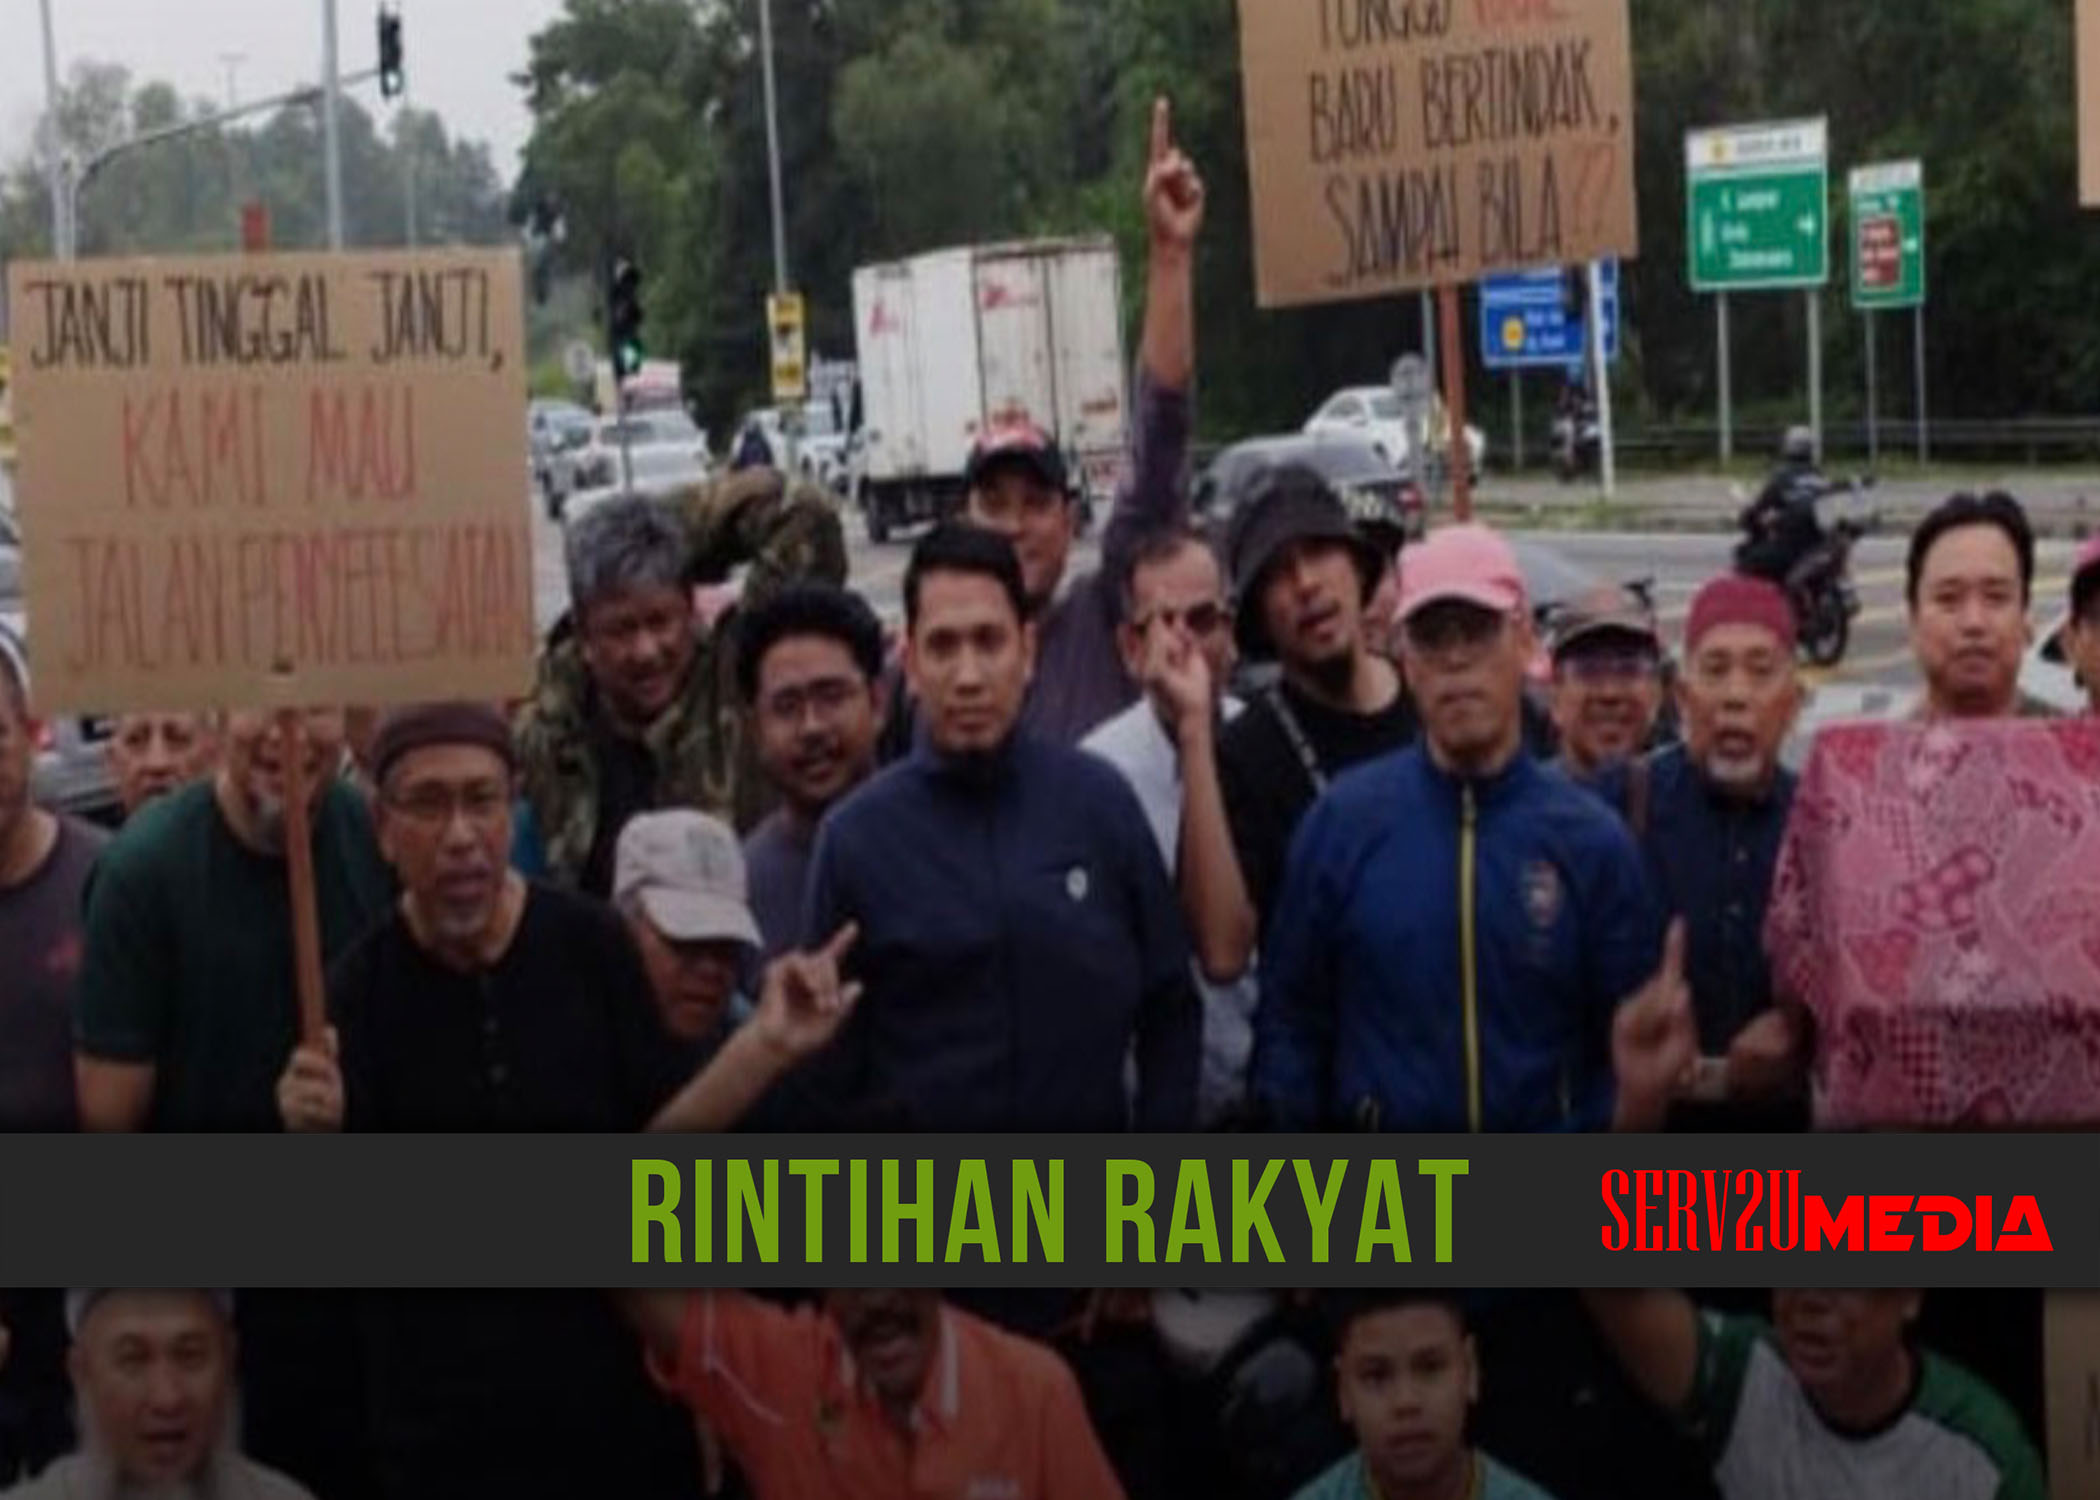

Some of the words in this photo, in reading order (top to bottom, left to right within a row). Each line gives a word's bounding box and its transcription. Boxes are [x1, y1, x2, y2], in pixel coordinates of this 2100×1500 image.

[1324, 163, 1460, 287] SAMPAI
[25, 276, 150, 369] JANJI
[165, 270, 347, 366] TINGGAL
[368, 266, 504, 373] JANJI,
[122, 385, 267, 508] KAMI
[308, 384, 416, 501] MAU
[62, 532, 224, 670] JALAN
